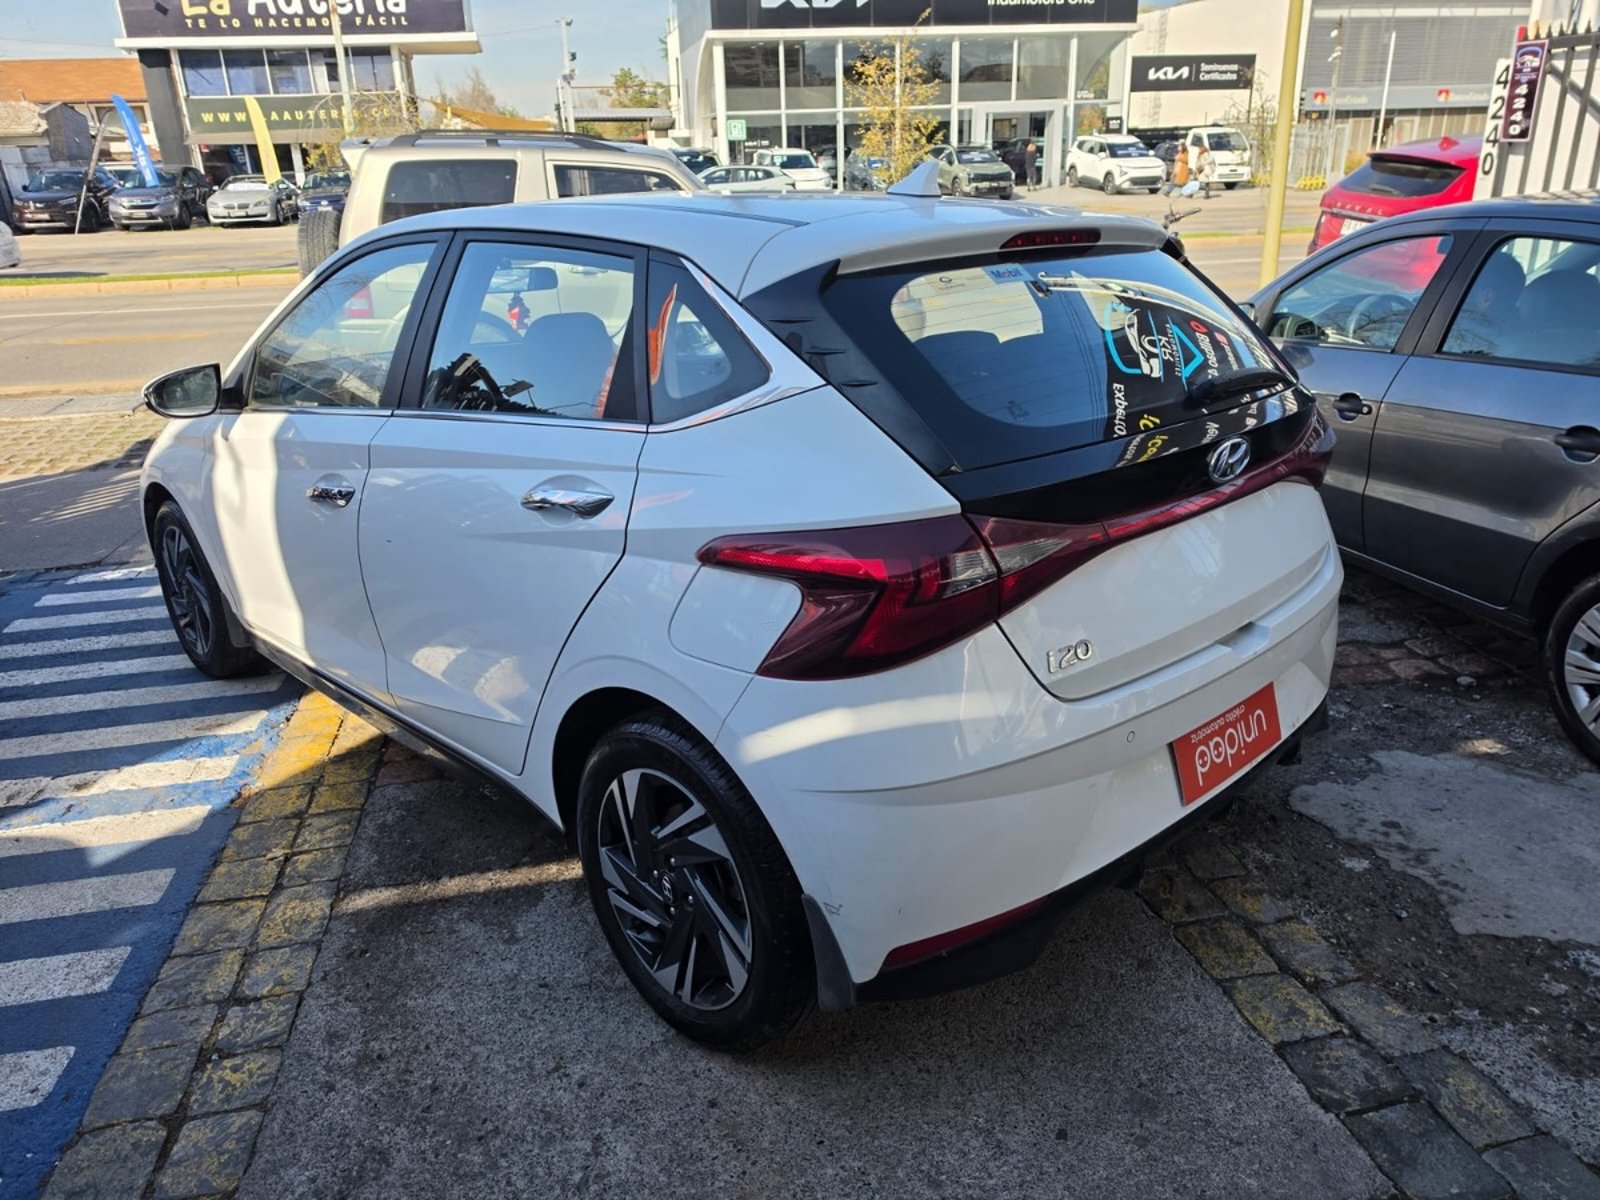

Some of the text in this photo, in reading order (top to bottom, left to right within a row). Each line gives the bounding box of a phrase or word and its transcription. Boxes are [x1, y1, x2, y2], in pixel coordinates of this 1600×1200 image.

[184, 14, 408, 28] TE LO HACEMO FÁCIL
[1509, 84, 1529, 135] 4240
[1047, 639, 1093, 674] i20
[1194, 708, 1268, 786] unidad
